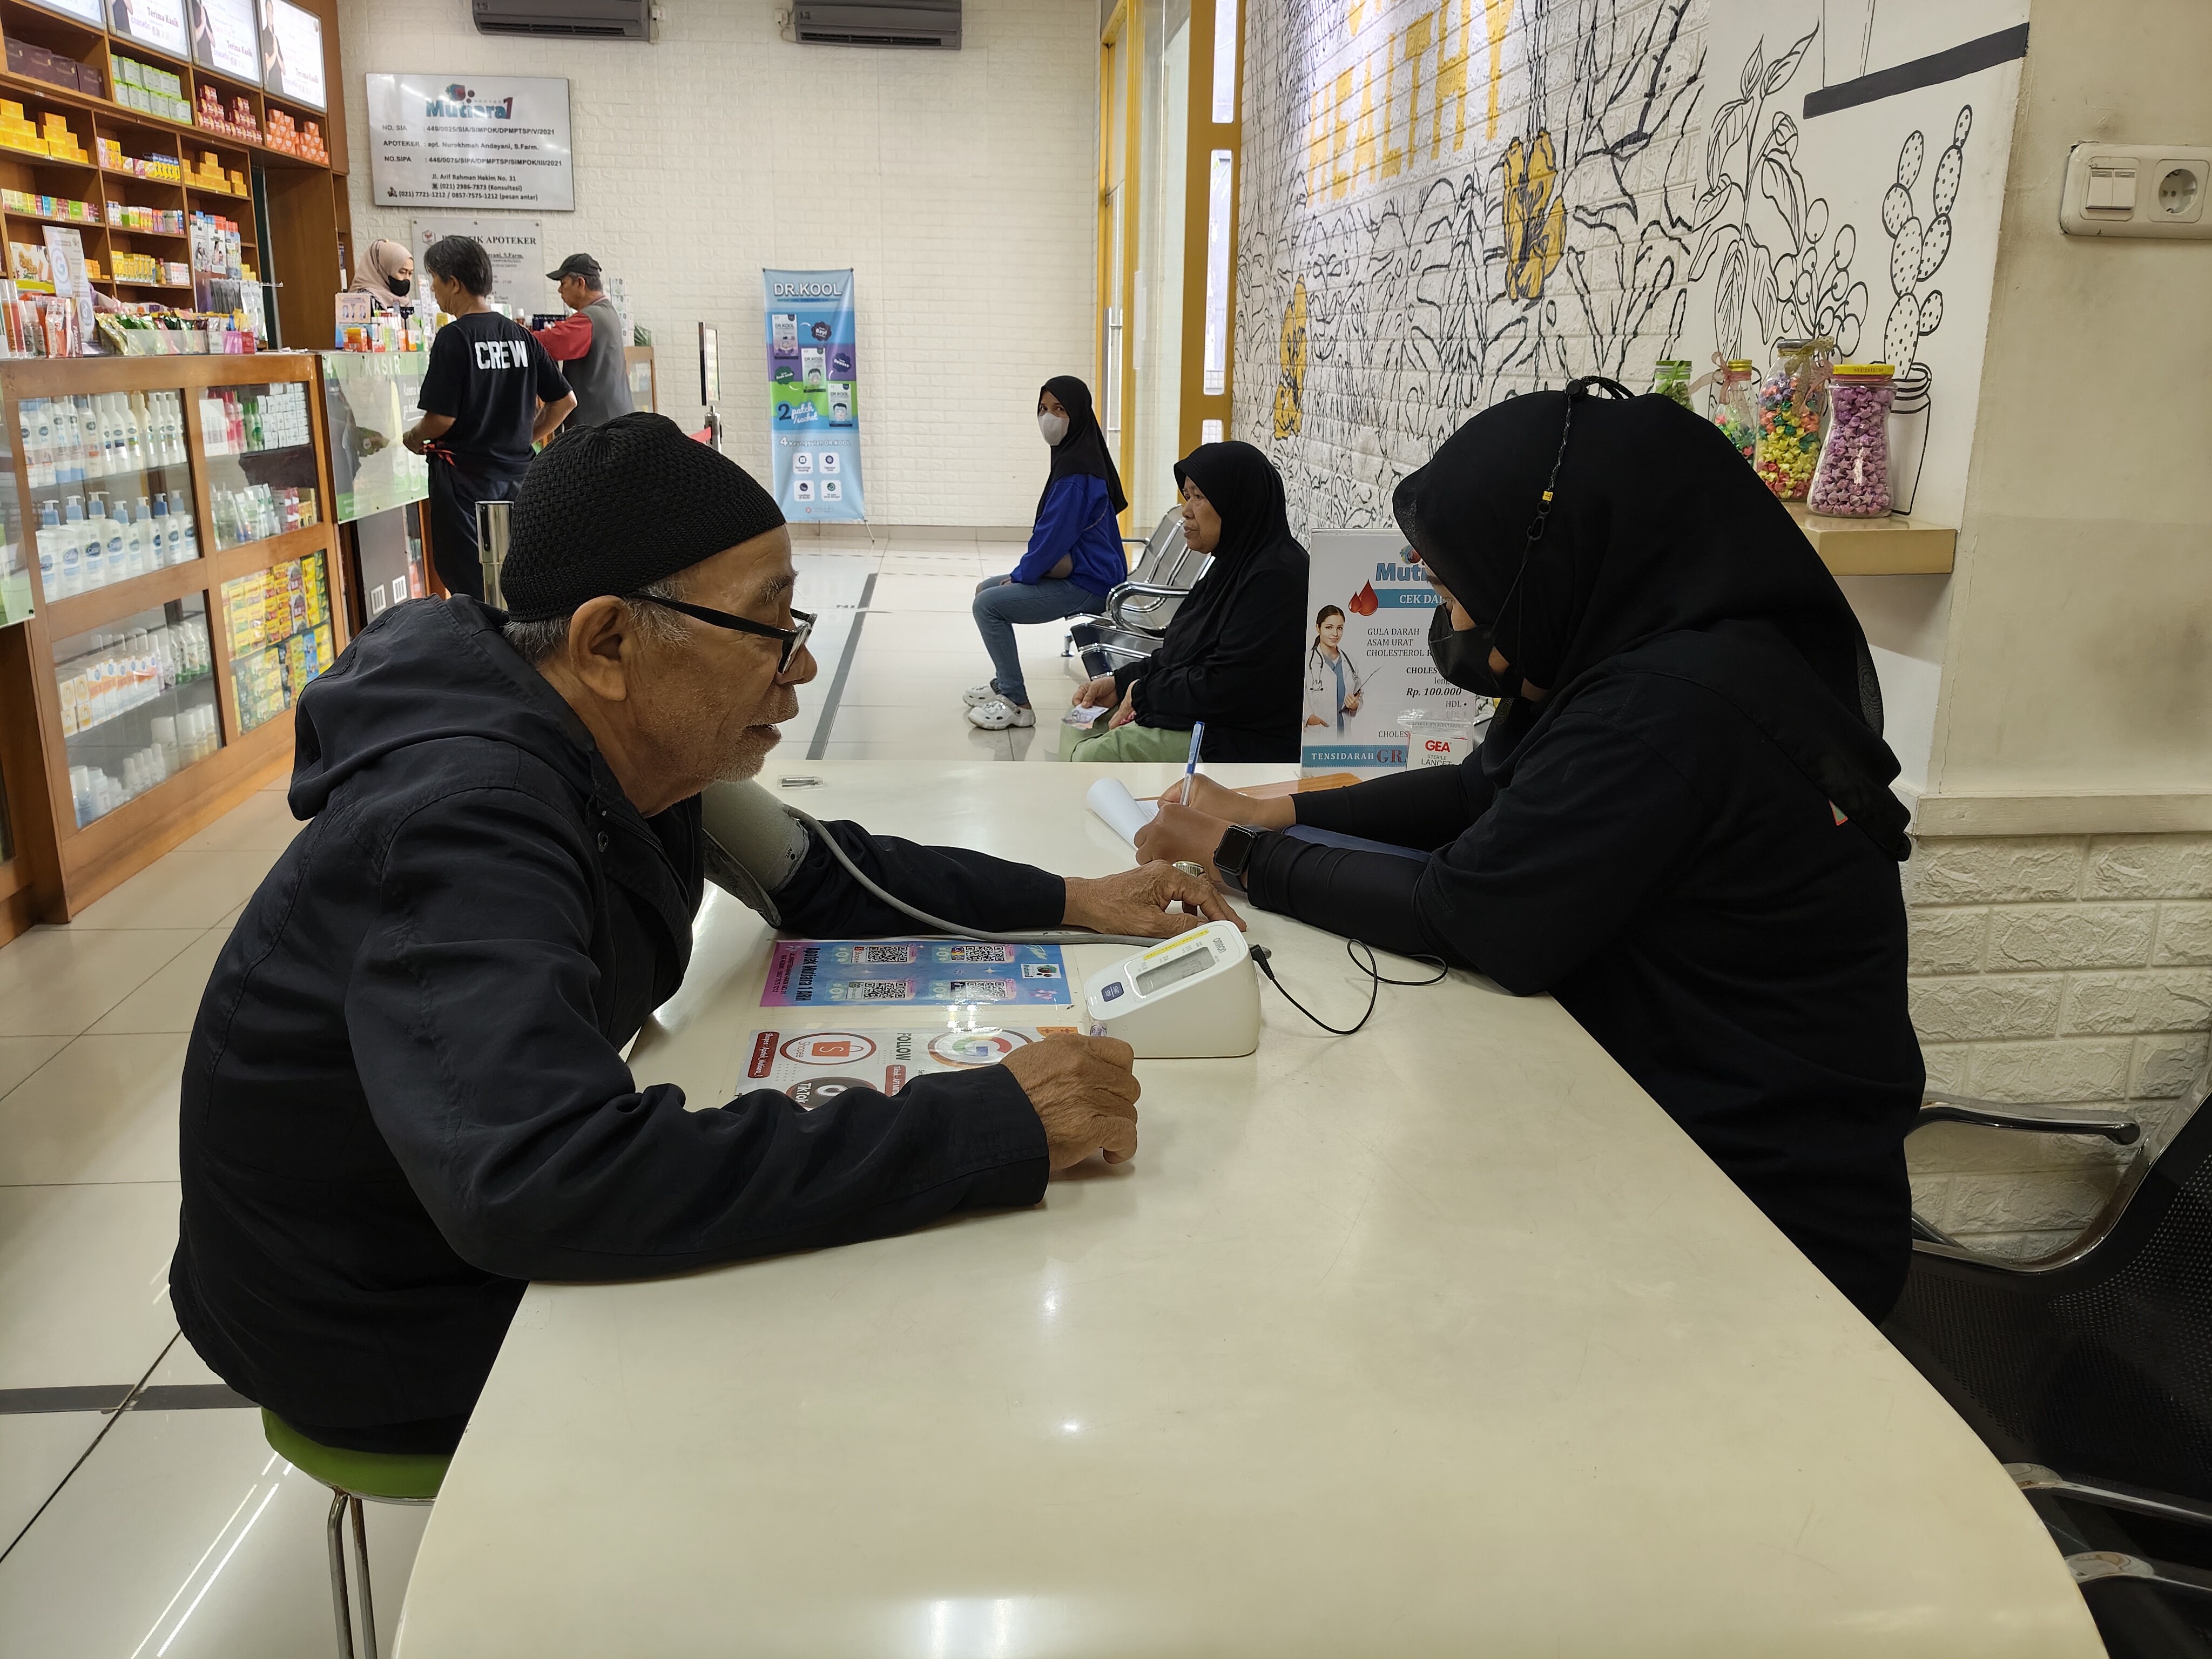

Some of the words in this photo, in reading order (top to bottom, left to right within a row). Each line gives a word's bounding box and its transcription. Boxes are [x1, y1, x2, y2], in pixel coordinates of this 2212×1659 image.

[147, 6, 164, 22] Terima
[165, 14, 179, 28] Kasih
[226, 40, 241, 52] Terima
[1306, 0, 1513, 208] HEALTHY
[486, 235, 537, 245] APOTEKER
[774, 283, 842, 296] DR.KOOL
[475, 340, 529, 370] CREW
[365, 355, 401, 376] KASIR
[778, 403, 791, 421] 2
[791, 402, 814, 419] patch
[780, 436, 788, 447] 4
[1400, 595, 1421, 604] CEK
[1406, 687, 1421, 698] Rp.
[1424, 687, 1462, 696] 100.000
[1425, 740, 1450, 753] GEA
[803, 947, 821, 965] Apotek
[799, 966, 818, 986] Mutiara
[795, 990, 813, 1001] ARH
[793, 1041, 811, 1057] Shopee
[896, 1033, 912, 1061] FOLLOW
[795, 1082, 812, 1103] TikTok
